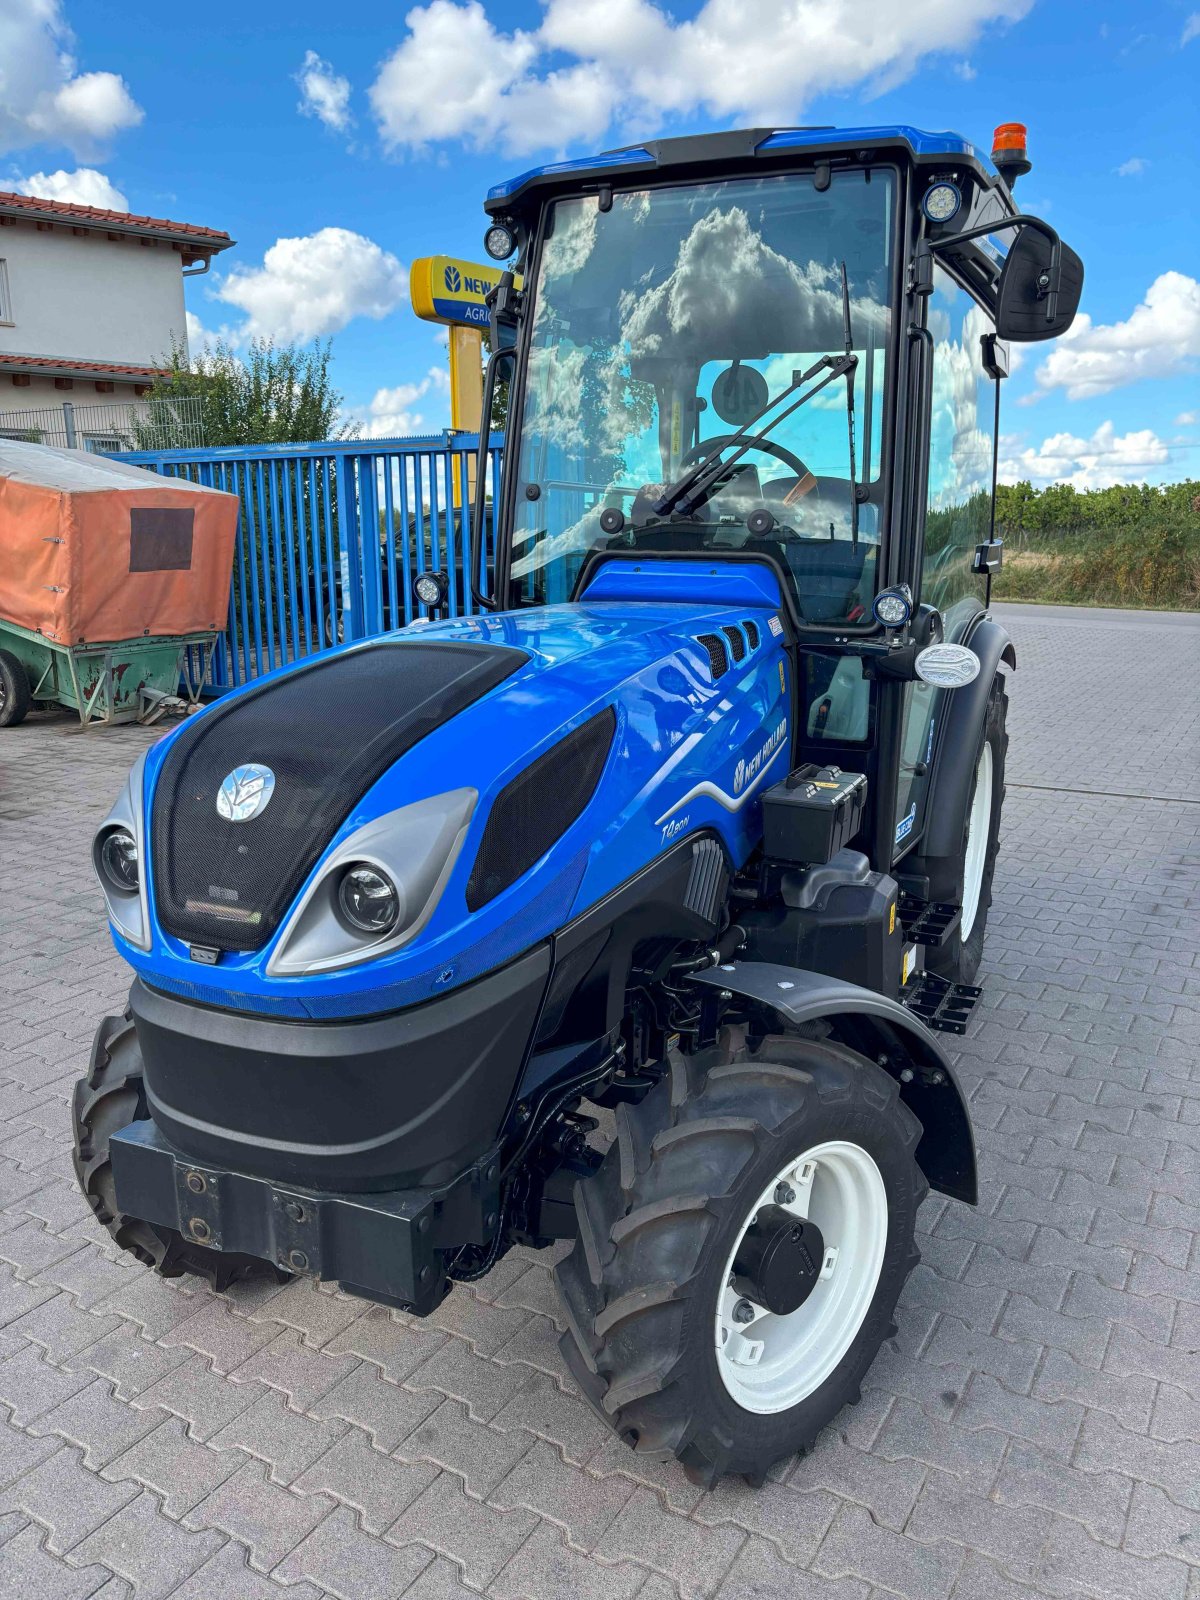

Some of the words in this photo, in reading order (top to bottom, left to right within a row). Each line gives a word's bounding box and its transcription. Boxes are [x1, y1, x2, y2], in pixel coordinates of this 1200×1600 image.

[464, 277, 491, 295] NEW
[744, 749, 762, 784] NEW
[762, 717, 787, 763] HOLLAND
